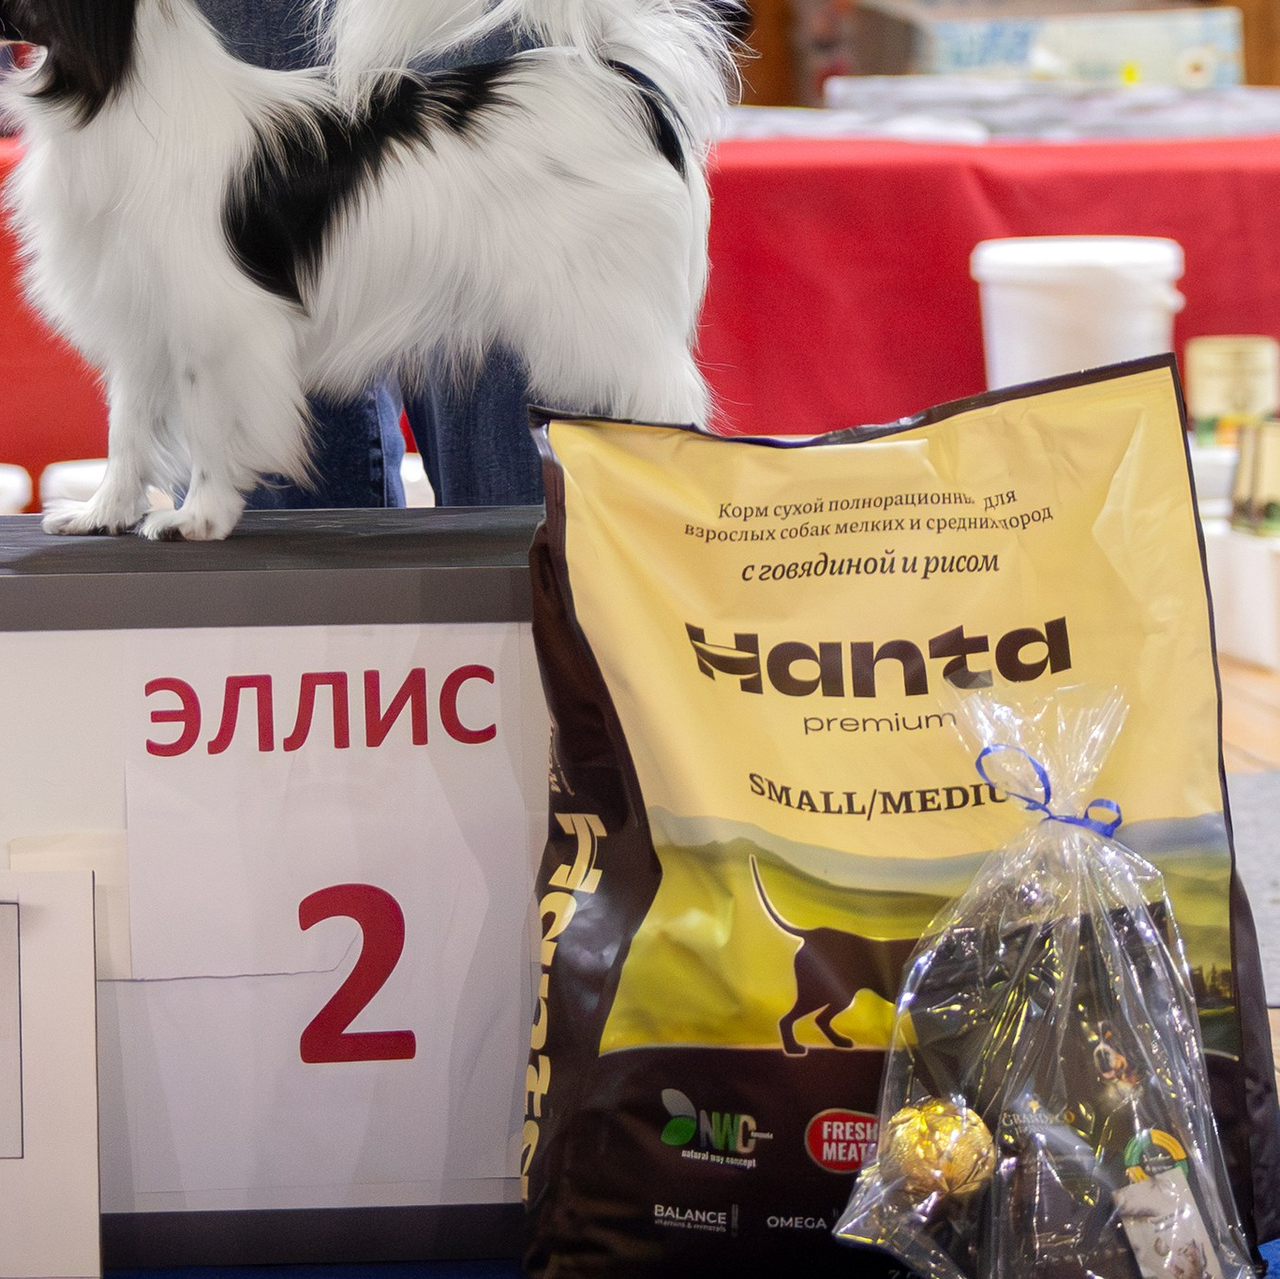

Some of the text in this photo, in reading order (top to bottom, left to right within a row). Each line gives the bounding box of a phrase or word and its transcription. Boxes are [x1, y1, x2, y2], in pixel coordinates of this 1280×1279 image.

[718, 503, 768, 522] Корм
[773, 497, 824, 520] сухой
[983, 490, 1018, 512] для
[685, 522, 776, 543] взрослых
[780, 520, 831, 540] собак
[834, 517, 905, 535] мелких
[909, 517, 921, 531] и
[926, 515, 999, 534] средних
[742, 550, 1000, 581] с говядиной и рисом
[685, 616, 1072, 698] Hanta
[144, 664, 497, 757] ЭЛЛИС
[804, 711, 957, 735] premium
[749, 773, 1010, 821] SMALL/MEDIU
[298, 883, 417, 1064] 2
[699, 1109, 757, 1154] NWC
[822, 1121, 878, 1141] FRESH
[654, 1203, 727, 1225] BALANCE
[767, 1215, 827, 1229] OMEGA
